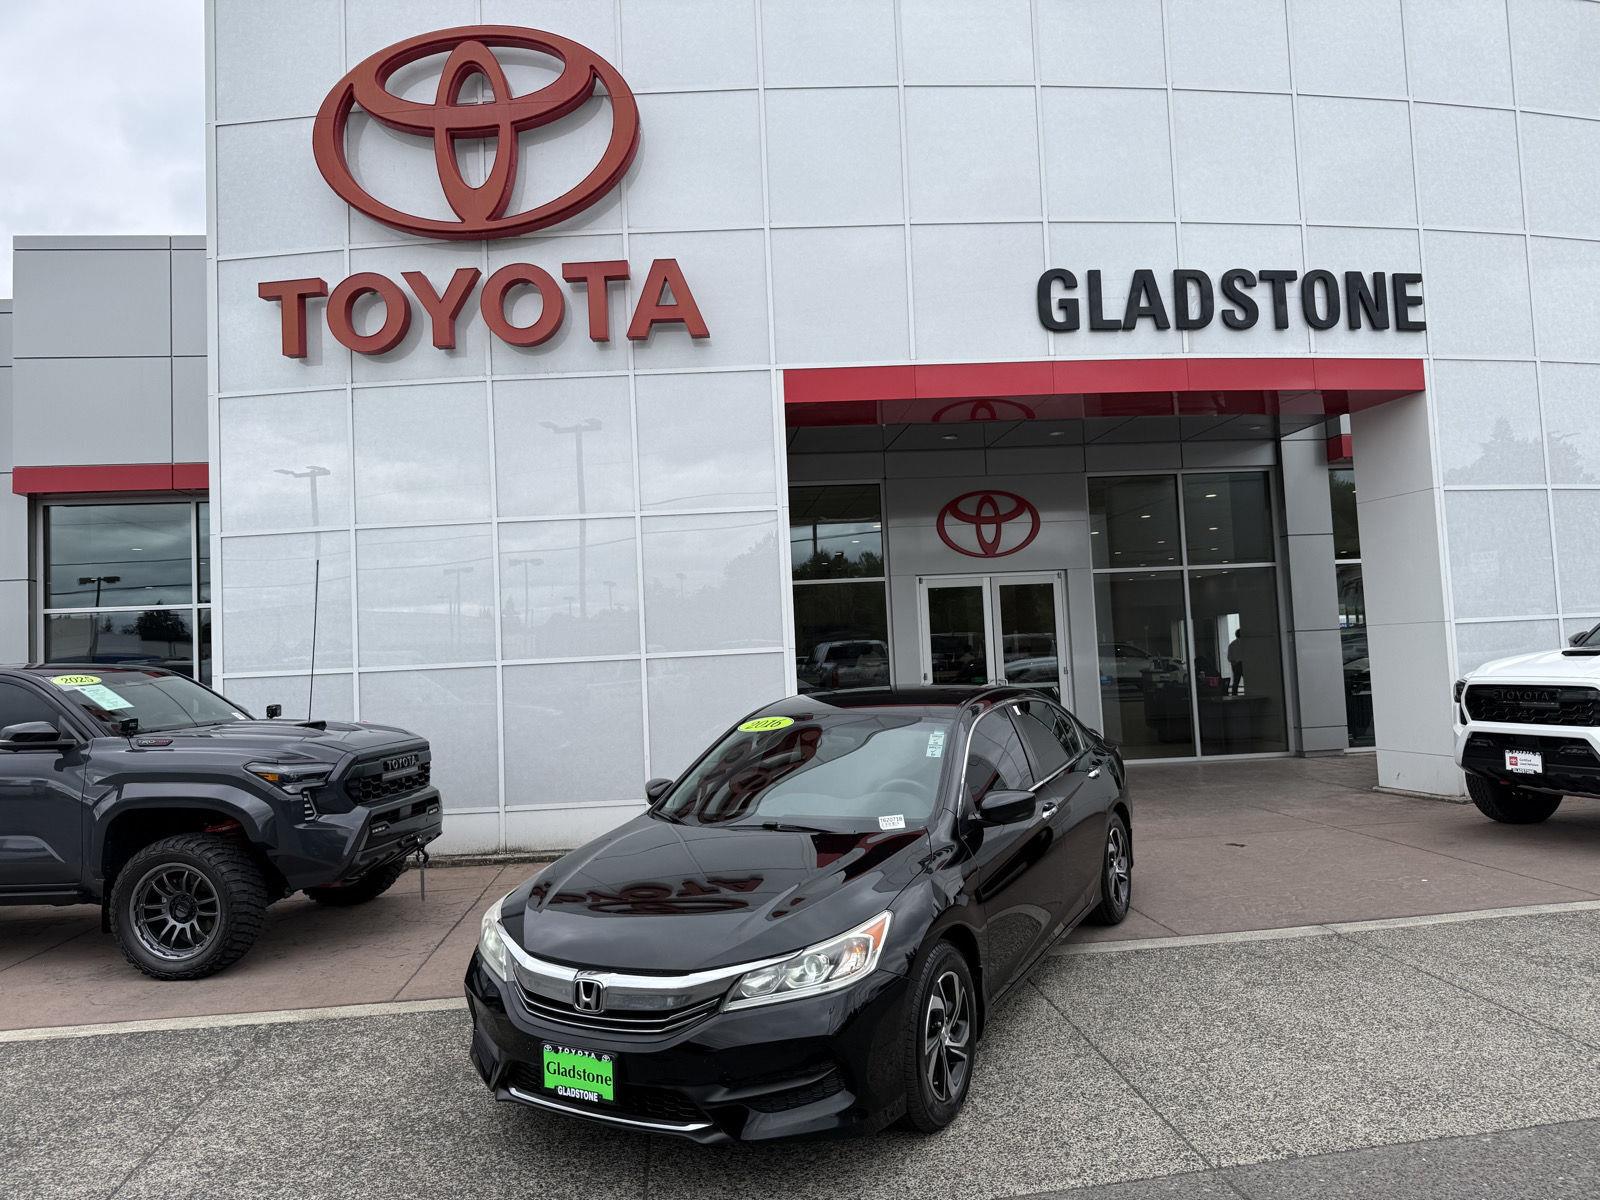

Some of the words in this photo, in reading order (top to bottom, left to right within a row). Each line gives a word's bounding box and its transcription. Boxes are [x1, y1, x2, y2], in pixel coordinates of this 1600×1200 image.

[1037, 268, 1426, 332] GLADSTONE
[258, 258, 710, 358] TOYOTA
[61, 676, 94, 684] 2025
[1500, 690, 1549, 700] TOYOTA
[745, 718, 786, 730] 2016
[387, 755, 417, 770] TOYOTA
[557, 1046, 596, 1059] TOYOTA
[546, 1061, 612, 1086] Gladstone
[557, 1085, 599, 1102] GLADSTONE
